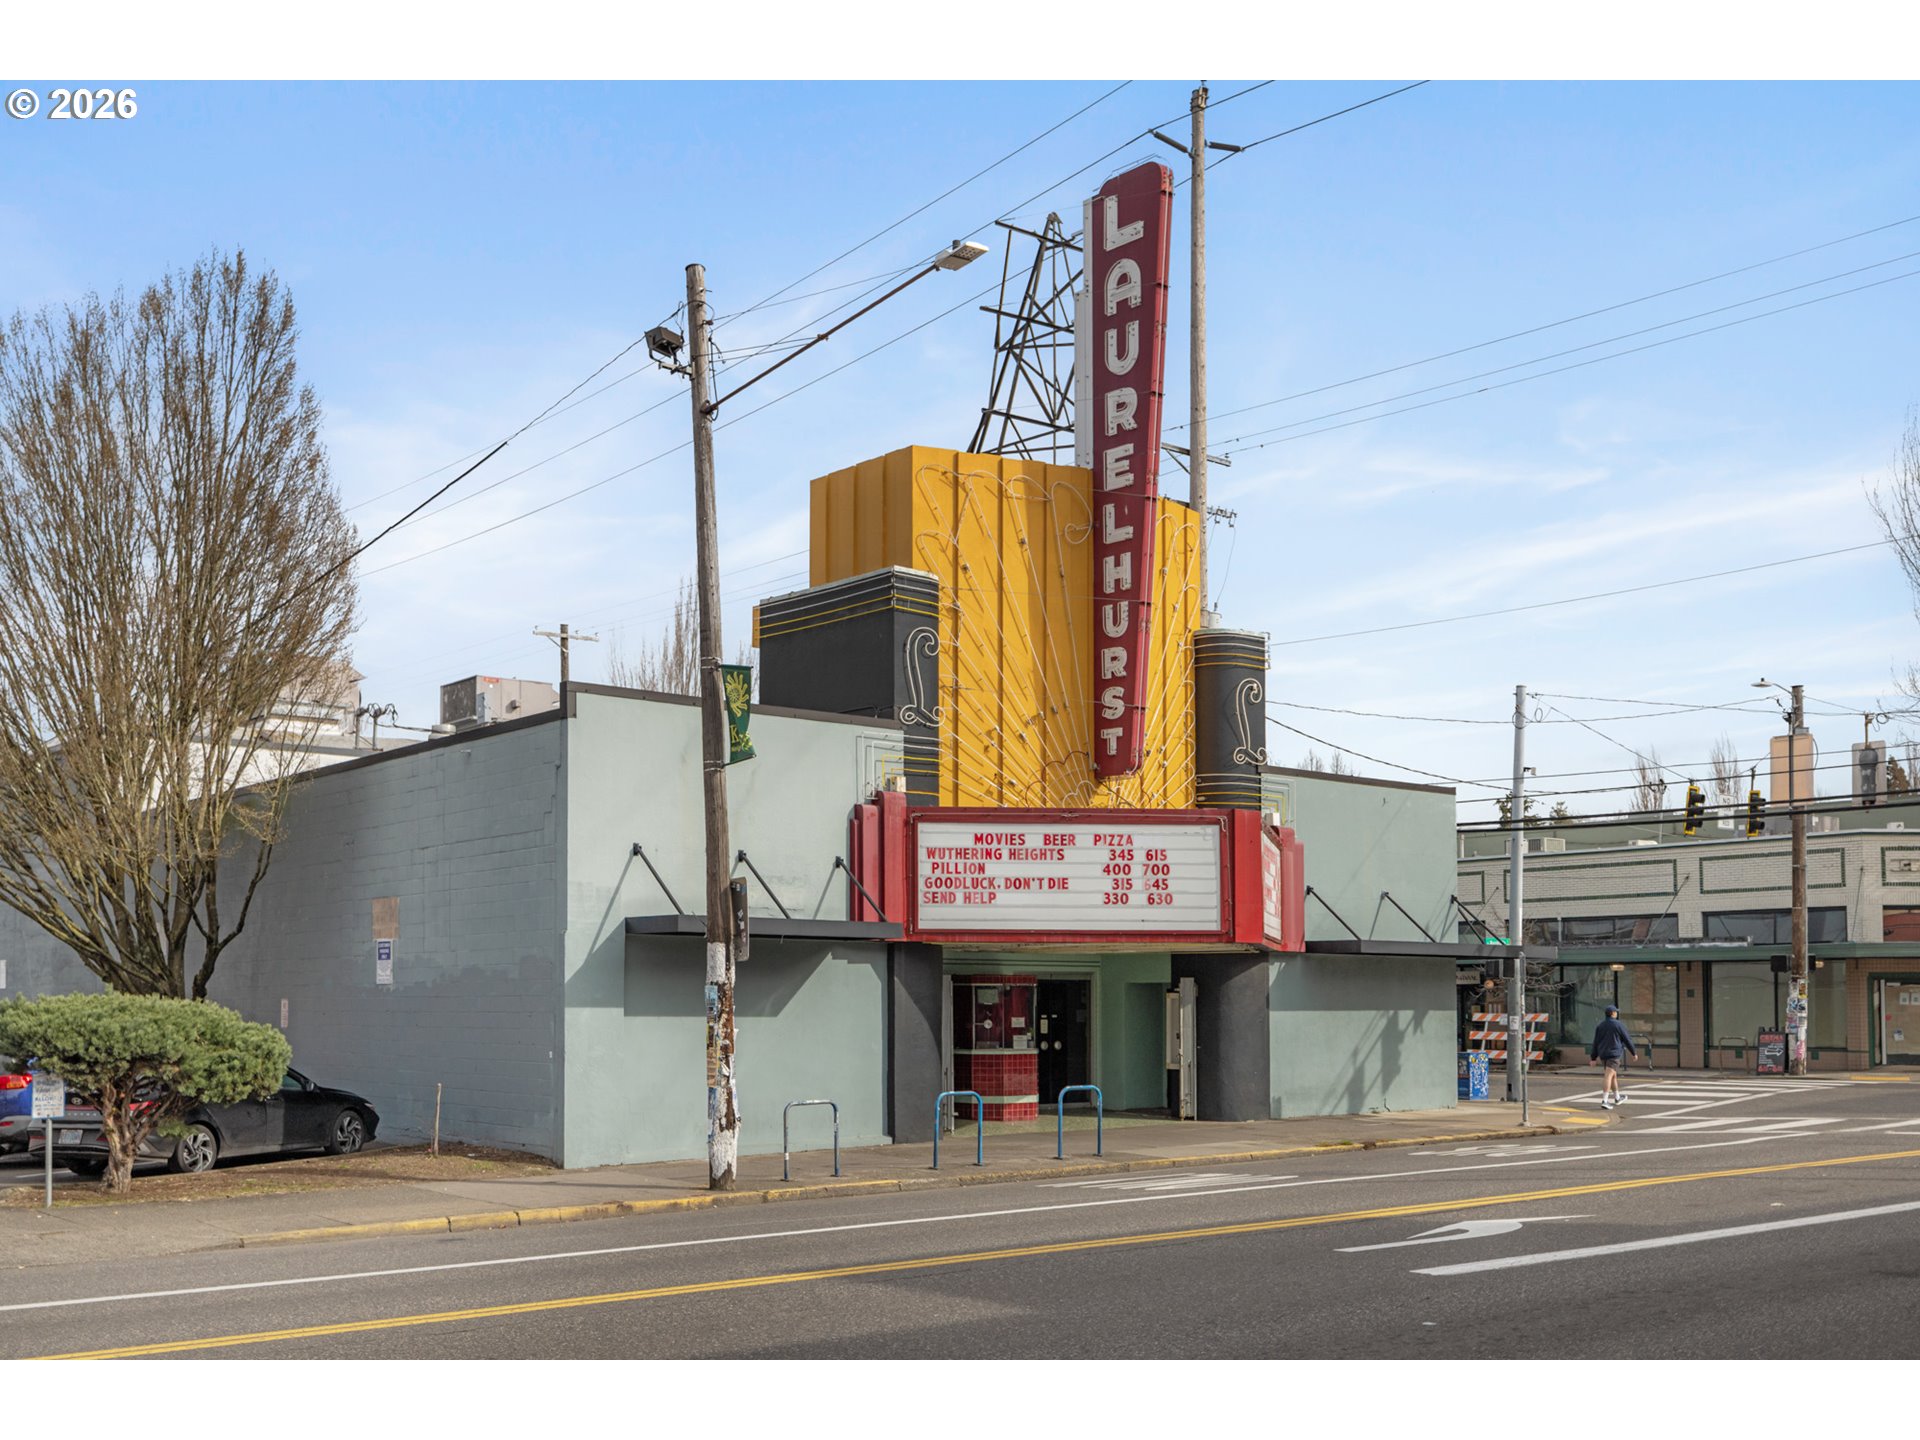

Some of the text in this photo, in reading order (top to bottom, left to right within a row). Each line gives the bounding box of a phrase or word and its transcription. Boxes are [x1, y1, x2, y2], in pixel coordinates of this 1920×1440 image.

[1102, 194, 1144, 757] LAURELHURST
[974, 832, 1134, 847] MOVIES BEER PIZZA
[926, 847, 1168, 862] WUTHERING HEIGHTS 345 615
[931, 862, 1171, 877] PILLION 400 700
[1004, 877, 1045, 890] DON'T
[1047, 877, 1070, 890] DIE
[1112, 878, 1133, 890] 315
[1144, 878, 1169, 890] 645
[922, 891, 1174, 905] SEND HELP 330 630
